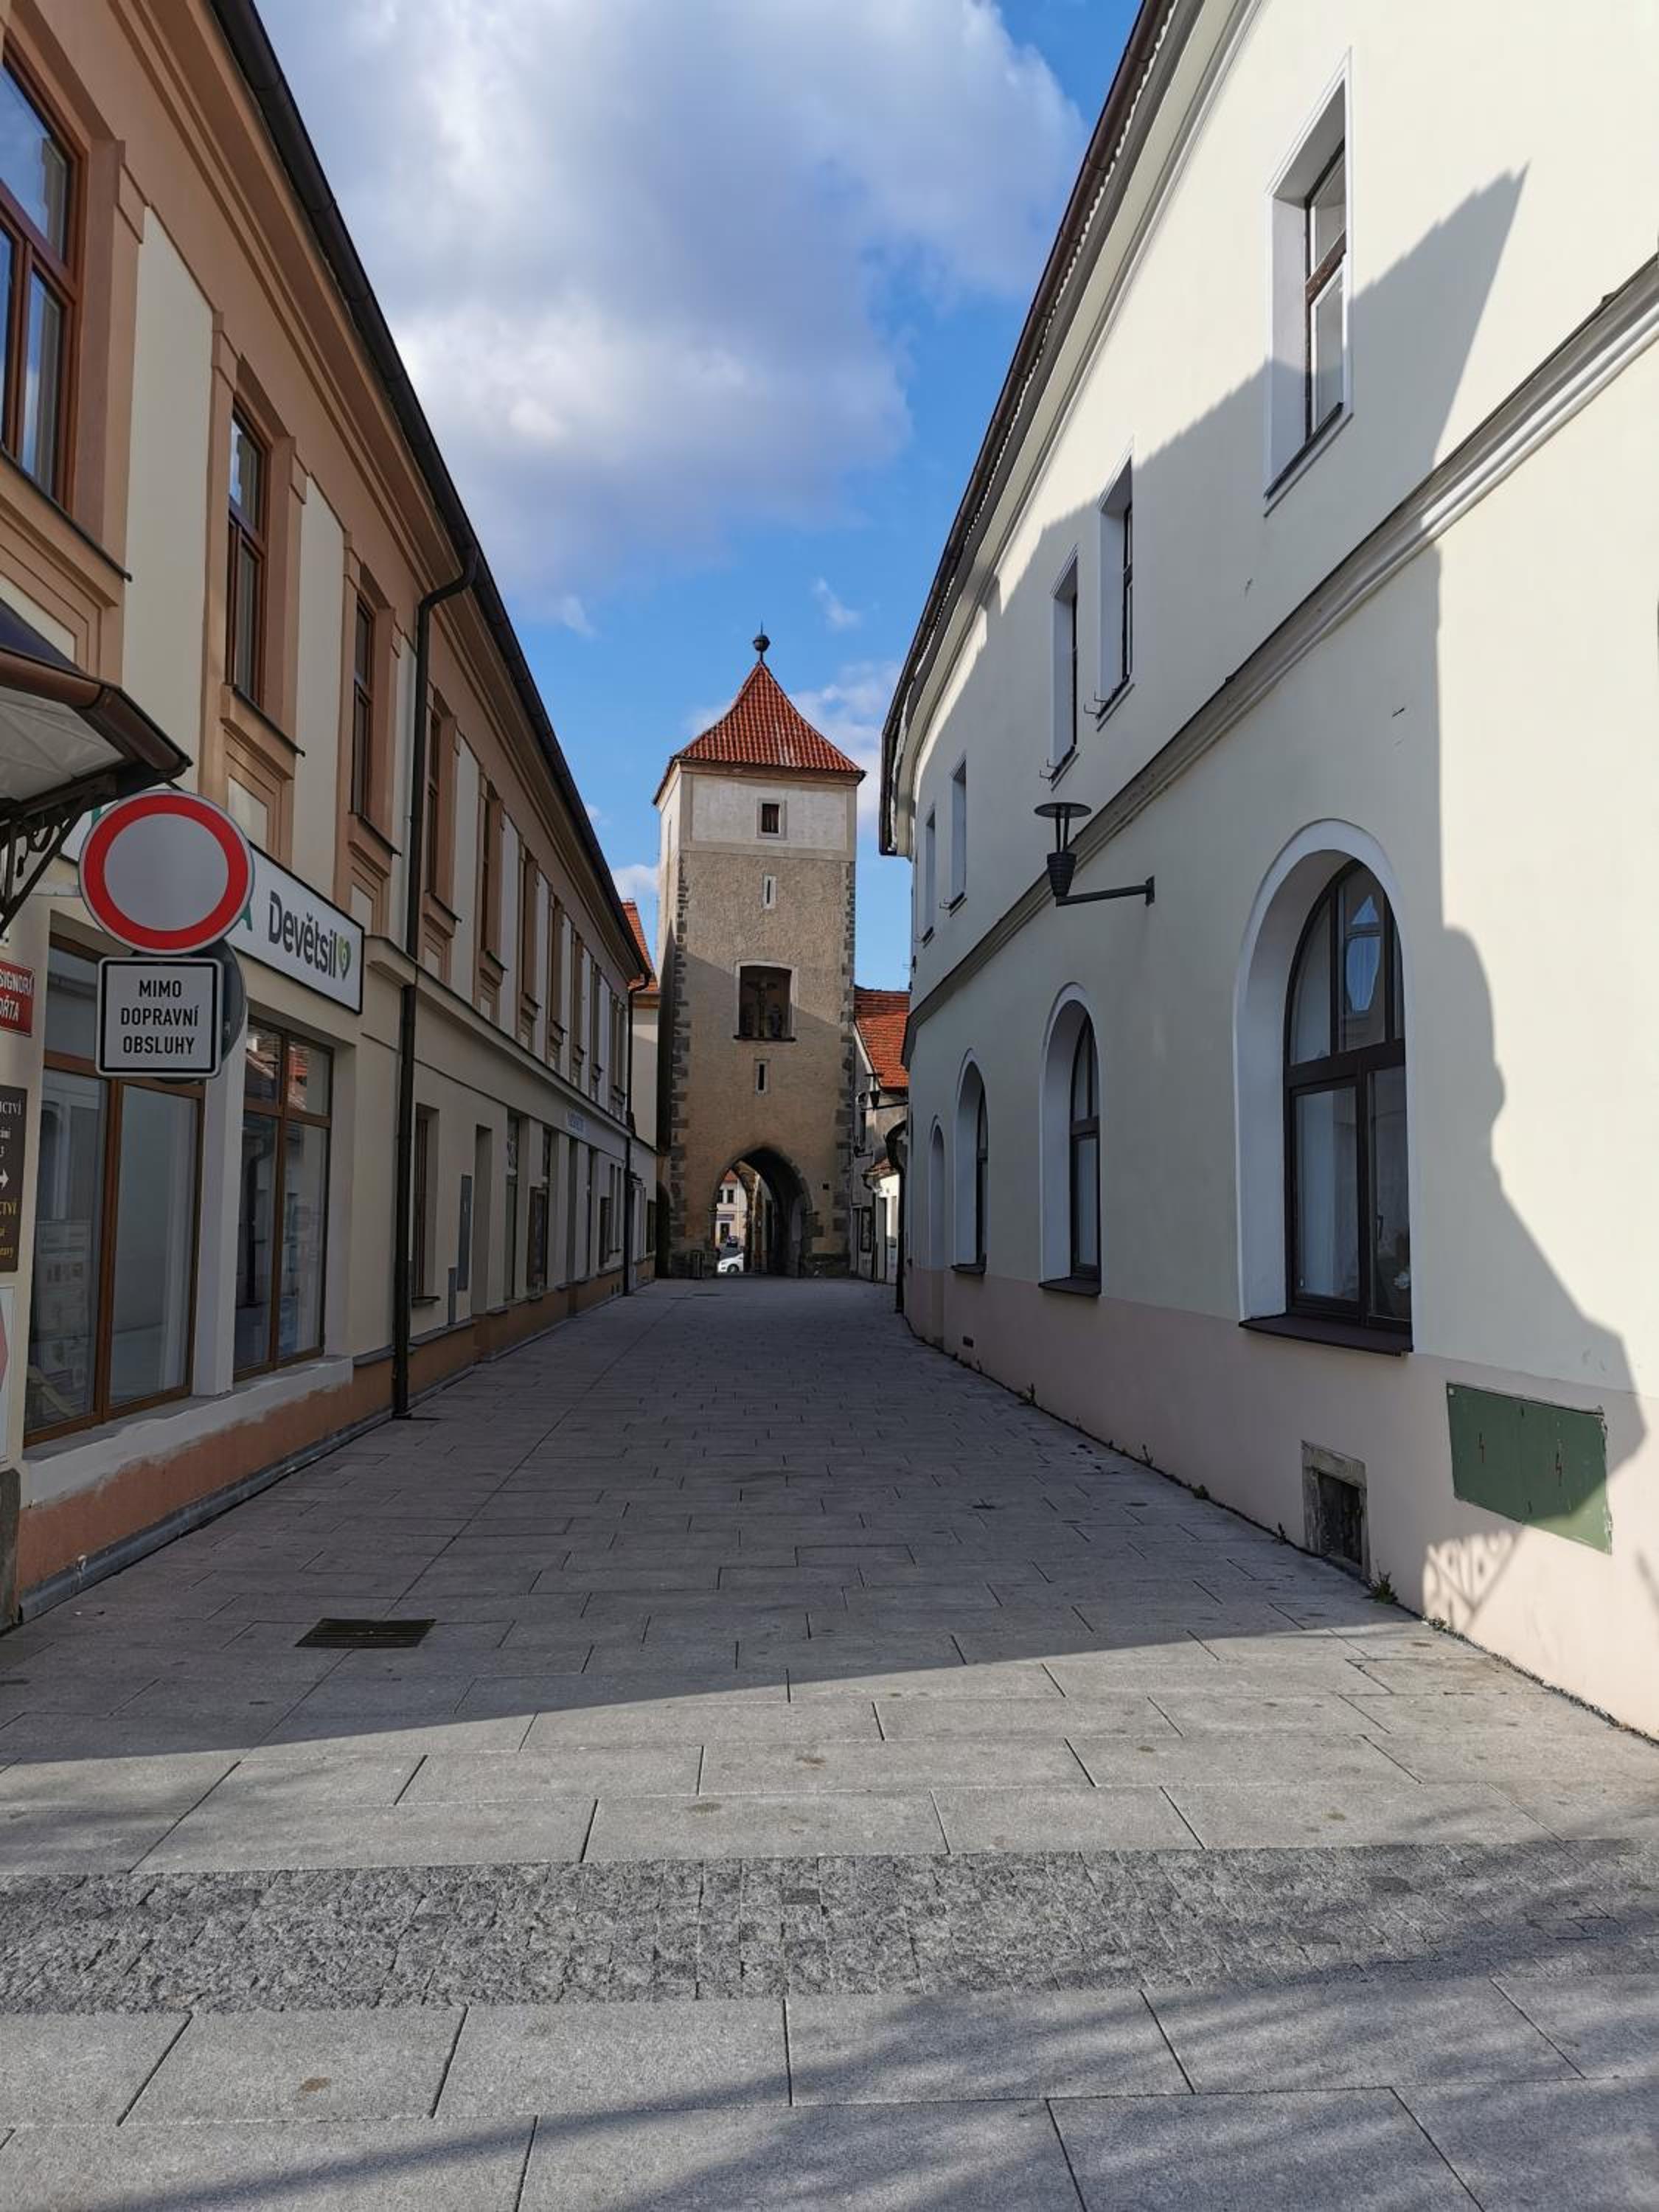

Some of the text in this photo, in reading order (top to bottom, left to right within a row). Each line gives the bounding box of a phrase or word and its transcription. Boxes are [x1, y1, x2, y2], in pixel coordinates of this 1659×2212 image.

[268, 889, 337, 979] Devětsil
[139, 979, 181, 998] MIMO
[120, 1004, 199, 1027] DOPRAVNÍ
[123, 1035, 195, 1054] OBSLUHY
